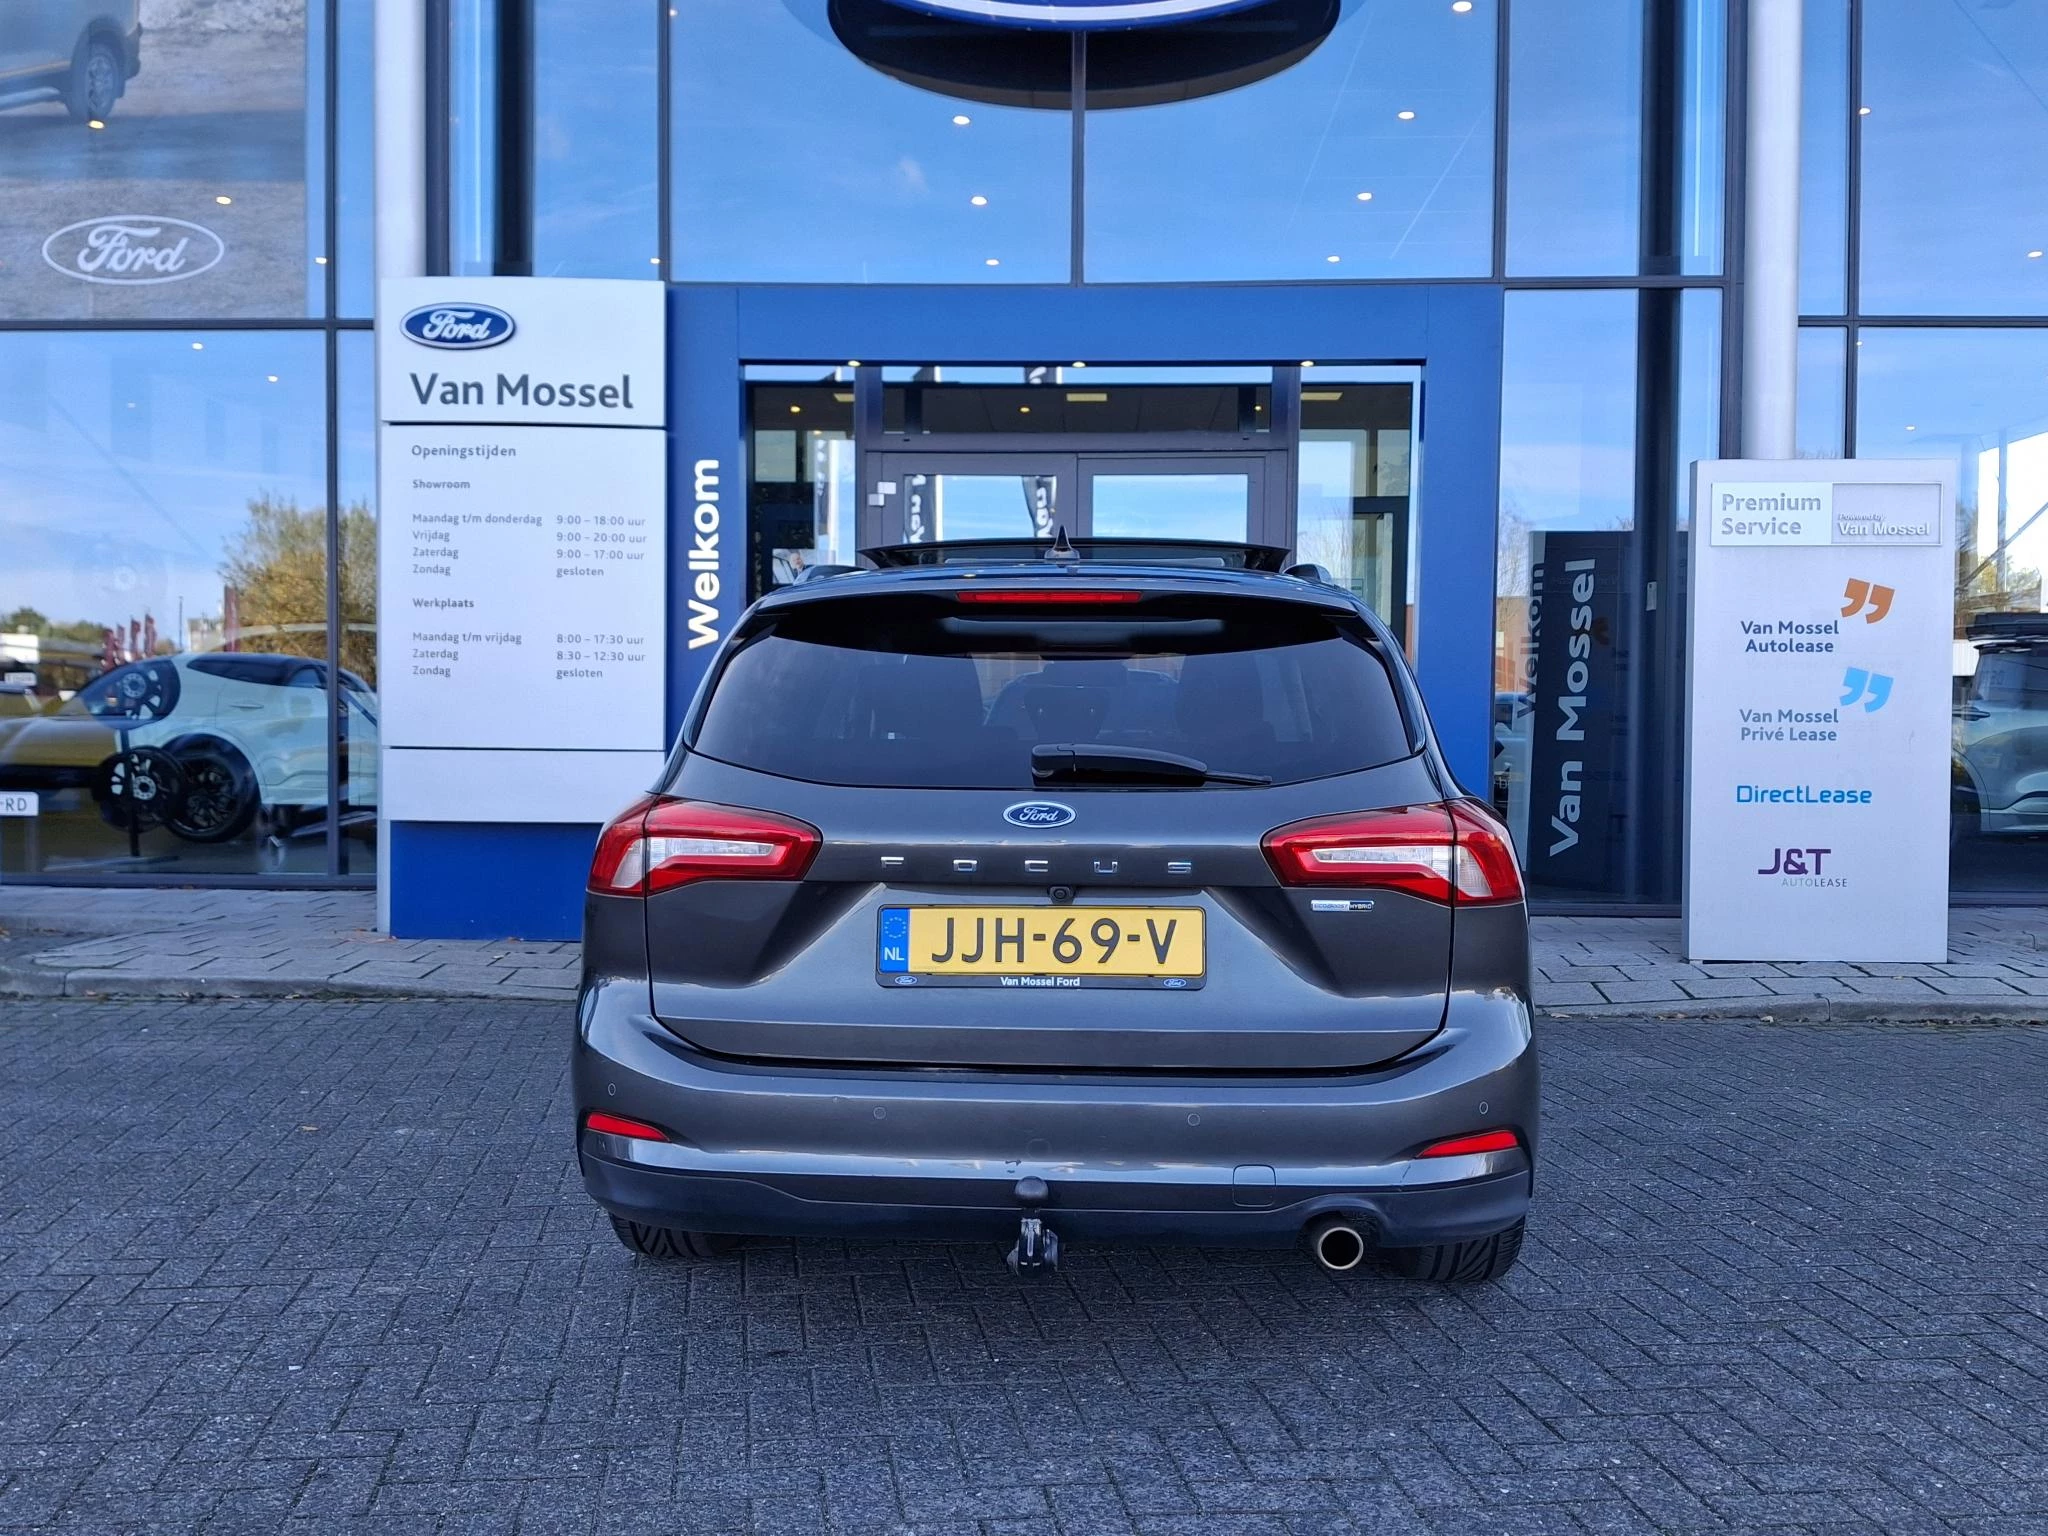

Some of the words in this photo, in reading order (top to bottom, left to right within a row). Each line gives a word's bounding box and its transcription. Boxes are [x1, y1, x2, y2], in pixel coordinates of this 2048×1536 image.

[77, 225, 189, 272] Ford
[410, 372, 484, 406] Van
[497, 373, 634, 409] Mossel
[411, 445, 516, 460] Openingstijden
[412, 479, 471, 490] Showroom
[1721, 493, 1821, 511] Premium
[412, 513, 459, 526] Maandag
[462, 513, 482, 524] t/m
[485, 513, 543, 526] donderdag
[556, 515, 581, 526] 9:00
[594, 515, 625, 526] 18:00
[627, 517, 646, 526] uur
[1721, 517, 1802, 535] Service
[1838, 522, 1868, 536] Van
[1872, 522, 1930, 536] Mossel
[412, 530, 450, 543] Vrijdag
[556, 532, 581, 543] 9:00
[593, 532, 625, 543] 20:00
[628, 534, 647, 543] uur
[412, 547, 459, 559] Zaterdag
[556, 549, 581, 560] 9:00
[594, 549, 624, 560] 17:00
[627, 551, 645, 560] uur
[688, 459, 720, 649] Welkom
[412, 564, 451, 576] Zondag
[556, 565, 604, 577] gesloten
[412, 598, 474, 610] Werkplaats
[1741, 620, 1773, 634] Van
[1778, 620, 1839, 634] Mossel
[412, 632, 459, 644] Maandag
[462, 631, 482, 642] t/m
[485, 632, 522, 645] vrijdag
[556, 634, 581, 645] 8:00
[594, 634, 624, 645] 17:30
[626, 636, 644, 645] uur
[1745, 638, 1834, 652] Autolease
[412, 649, 459, 661] Zaterdag
[556, 651, 581, 662] 8:30
[594, 651, 624, 662] 12:30
[627, 653, 646, 662] uur
[1556, 558, 1596, 741] Mossel
[412, 666, 451, 678] Zondag
[556, 668, 603, 679] gesloten
[1740, 709, 1772, 723] Van
[1778, 709, 1839, 723] Mossel
[1741, 727, 1785, 741] Privé
[1789, 727, 1837, 741] Lease
[1736, 785, 1872, 803] DirectLease
[1550, 761, 1583, 857] Van
[880, 856, 1192, 874] FOCUS
[1758, 848, 1831, 875] J&T
[1782, 878, 1848, 887] AUTOLEASE
[931, 917, 1177, 964] JJH-69-V
[883, 946, 904, 961] NL
[1000, 976, 1019, 986] Van
[1021, 976, 1055, 987] Mossel
[1057, 976, 1080, 987] Ford
